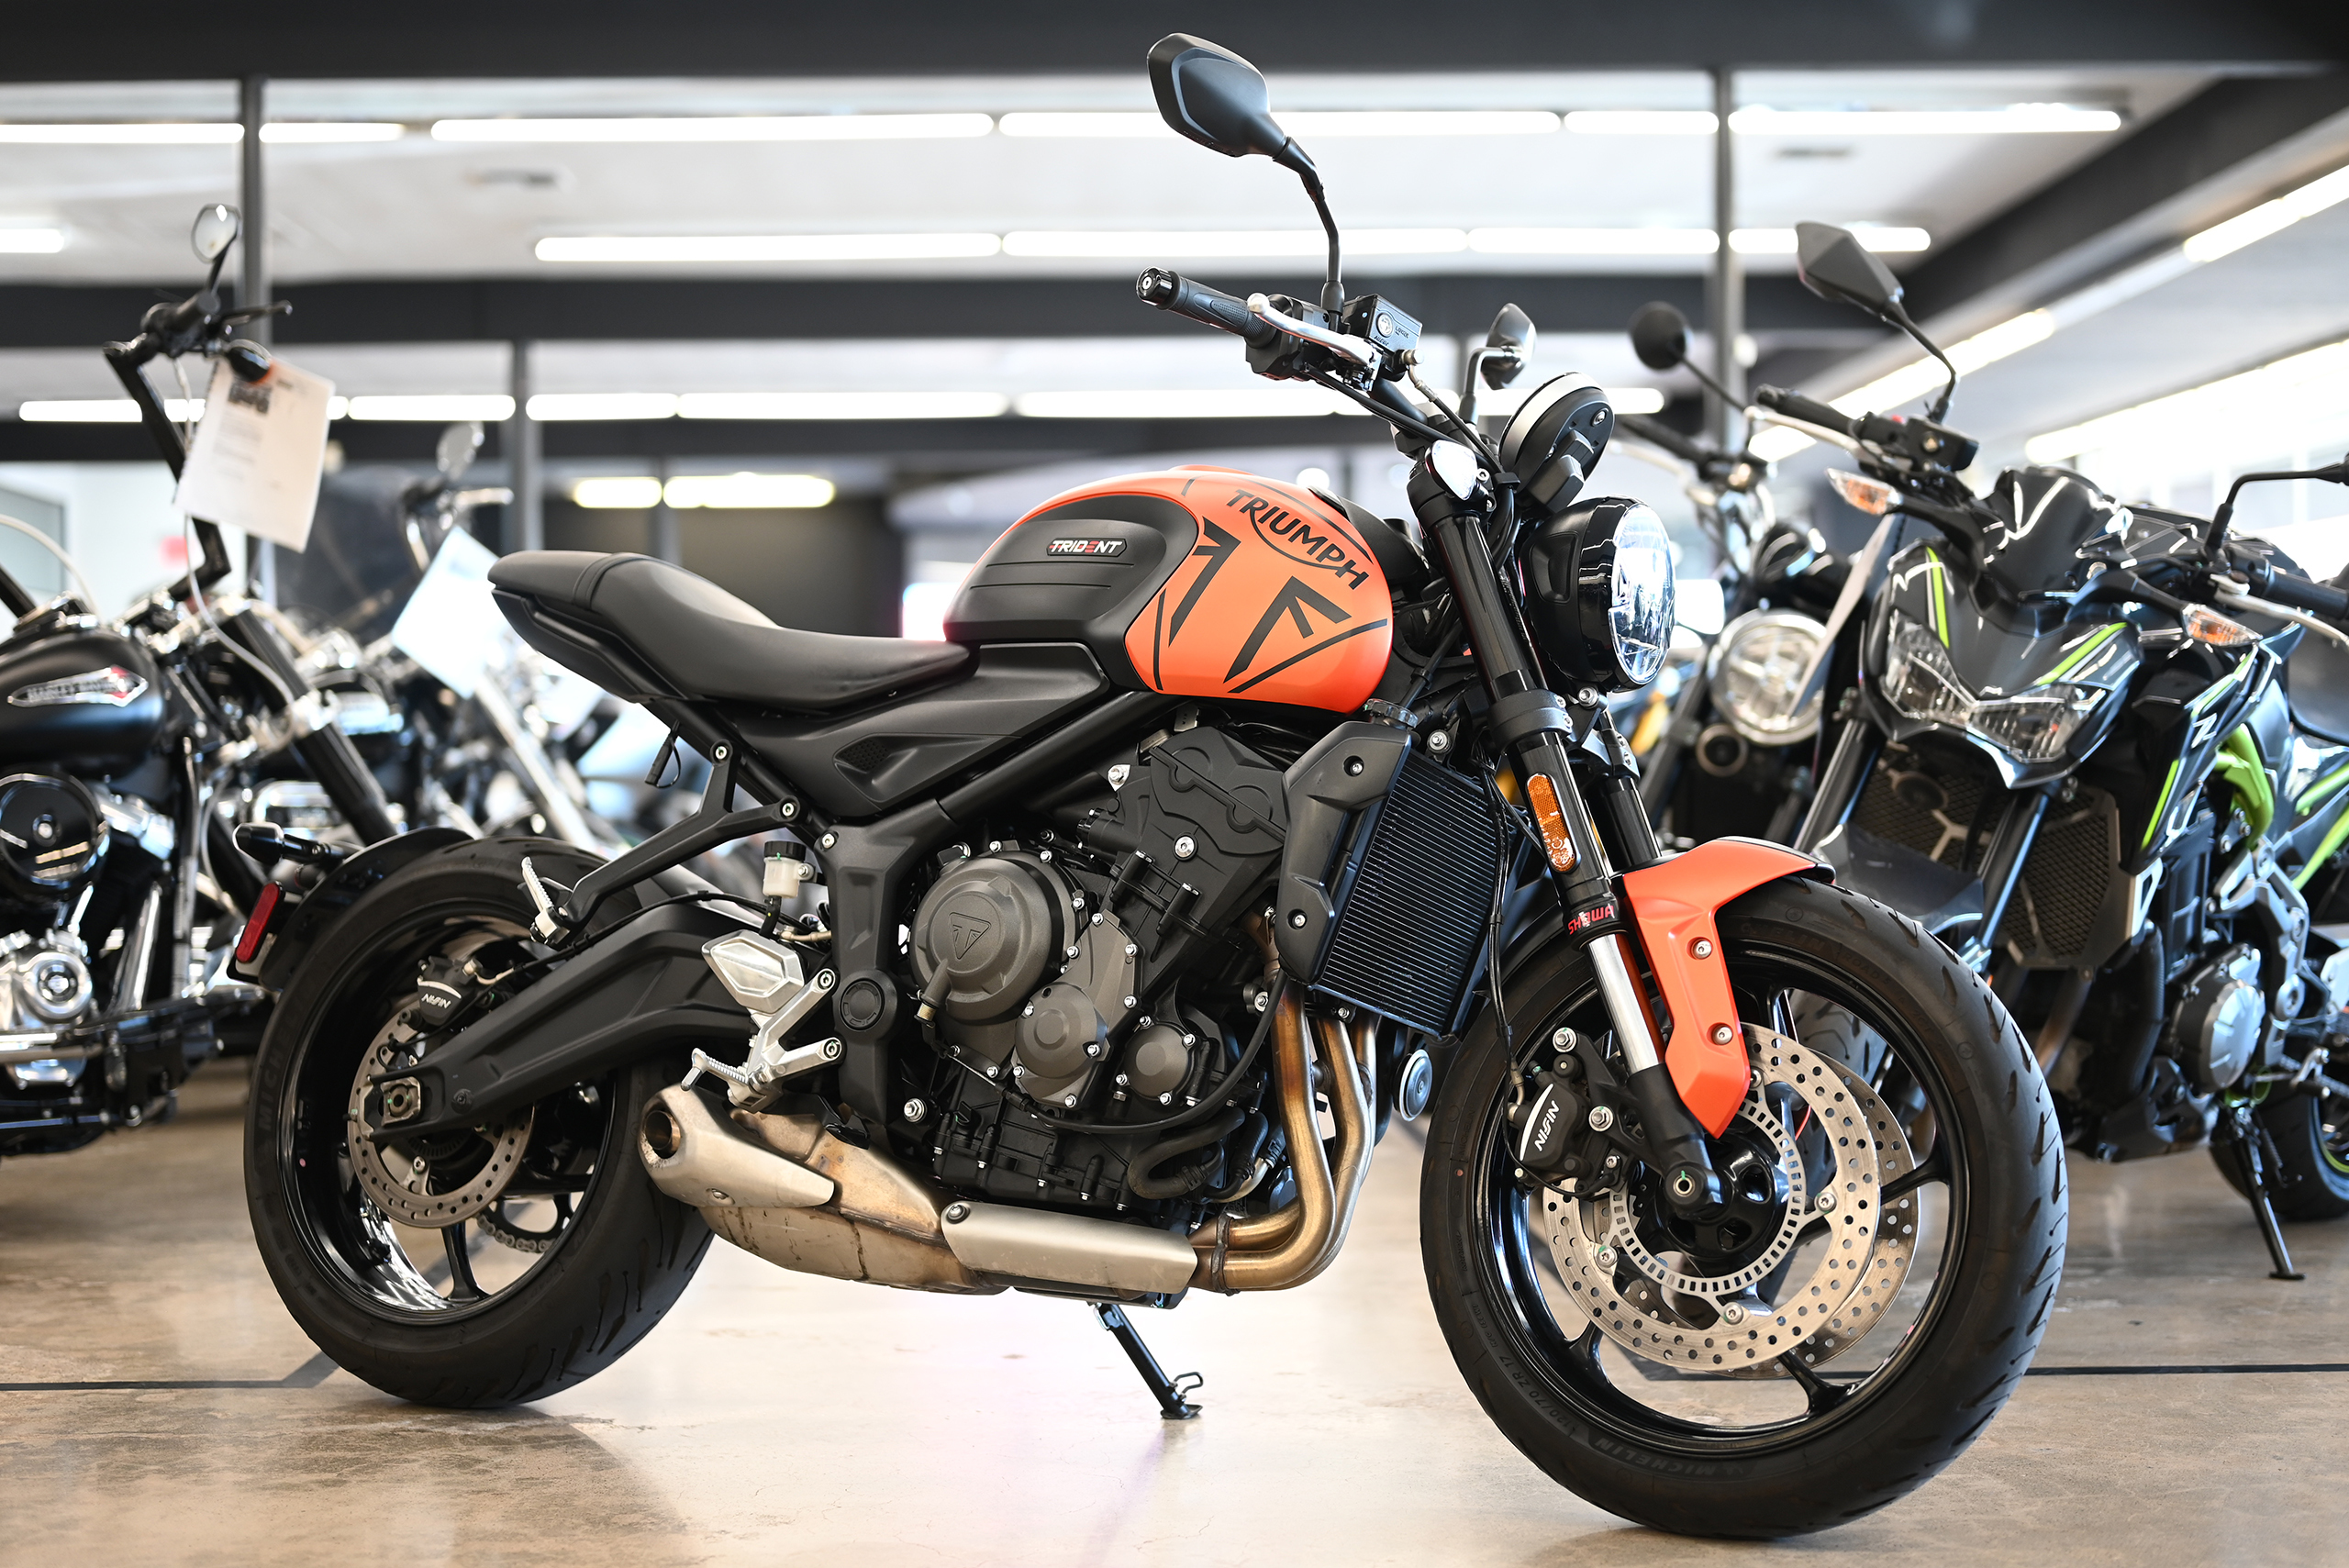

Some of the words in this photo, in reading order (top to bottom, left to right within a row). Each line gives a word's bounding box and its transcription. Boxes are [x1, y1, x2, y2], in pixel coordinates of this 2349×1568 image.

[1049, 539, 1122, 553] TRIDENT
[1226, 489, 1369, 590] TRIUMPH
[2191, 712, 2218, 750] Z
[1567, 905, 1615, 935] SHOWA
[1534, 1099, 1560, 1152] NISSIN
[1498, 1352, 1514, 1370] 17
[1511, 1369, 1531, 1389] ZR
[1528, 1389, 1578, 1430] 120/70
[1595, 1437, 1716, 1478] MICHELIN
